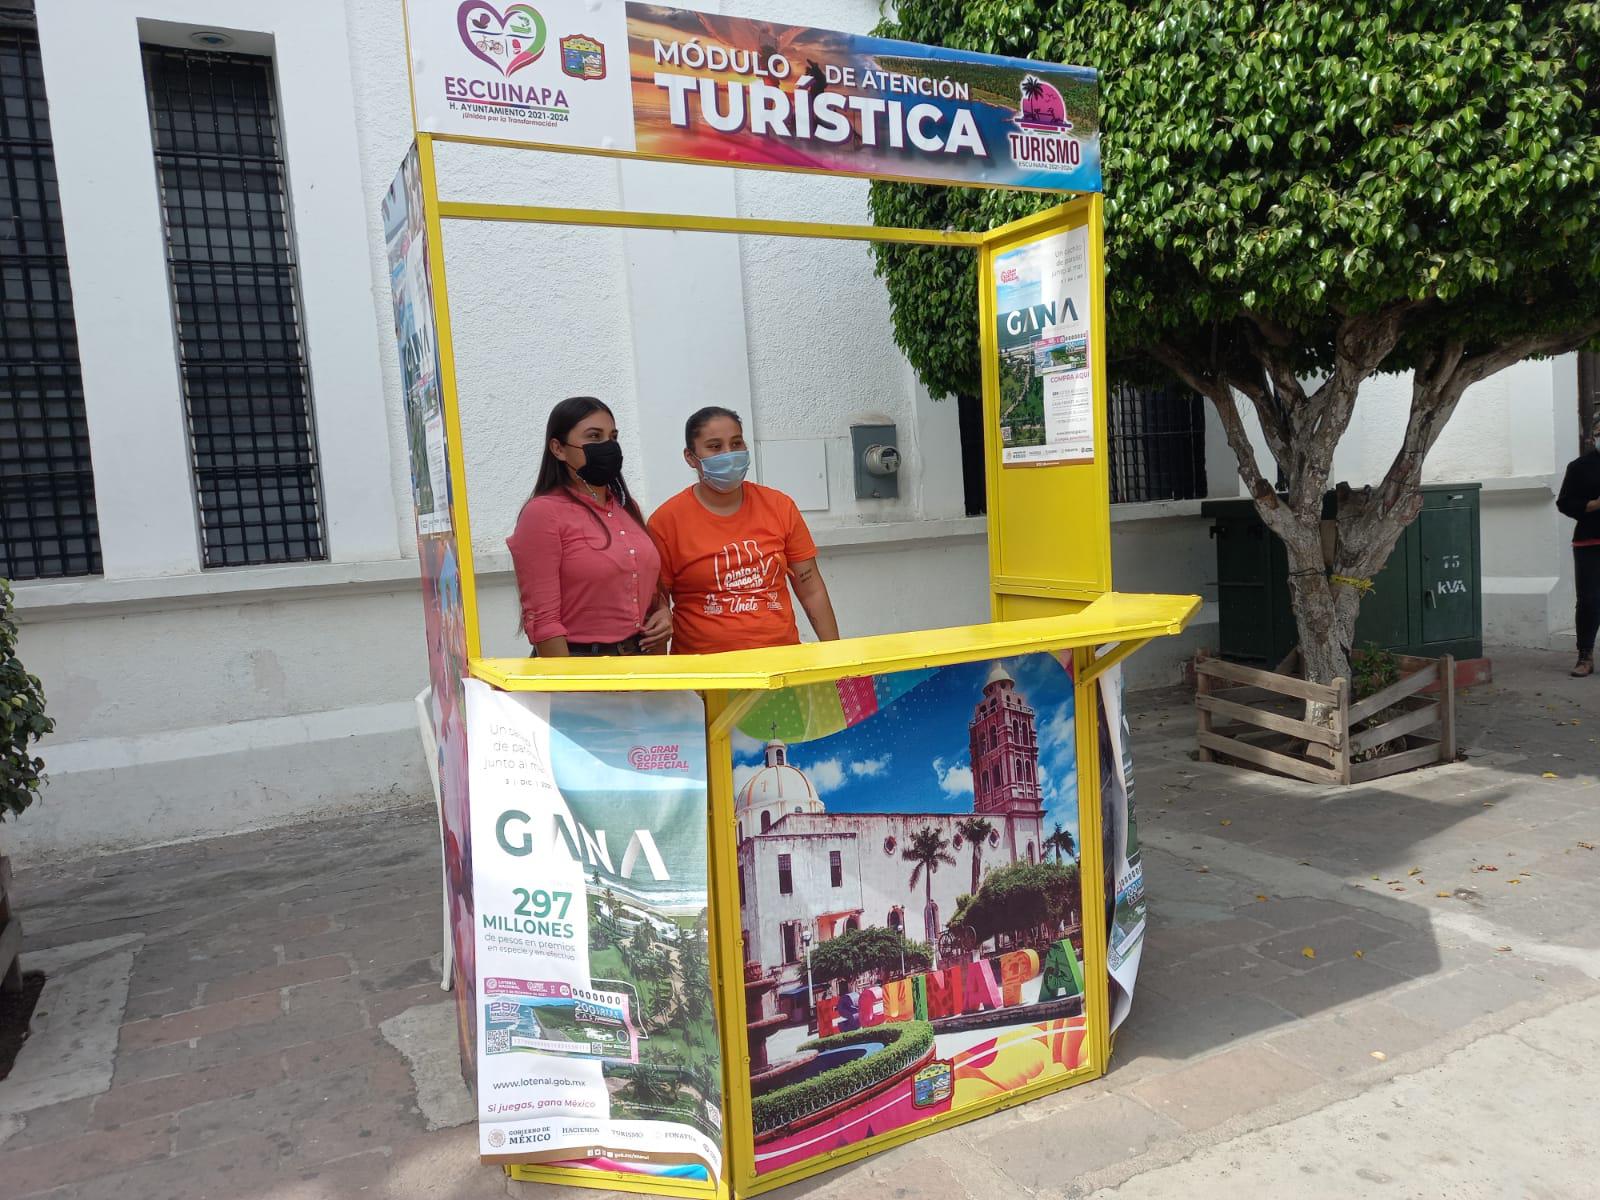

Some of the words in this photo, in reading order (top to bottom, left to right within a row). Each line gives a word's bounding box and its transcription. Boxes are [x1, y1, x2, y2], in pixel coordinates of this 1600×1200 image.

[653, 37, 790, 78] MÓDULO
[826, 65, 855, 87] DE
[862, 70, 969, 100] ATENCIÓN
[445, 76, 569, 108] ESCUINAPA
[450, 102, 458, 111] H.
[461, 103, 526, 117] AYUNTAMIENTO
[528, 110, 569, 122] 2021-2024
[654, 73, 986, 156] TURÍSTICA
[1009, 135, 1080, 165] TURISMO
[1006, 297, 1079, 335] GANA
[1437, 579, 1466, 594] kVA
[637, 752, 679, 762] SORTEO
[650, 744, 679, 753] GRAN
[636, 760, 689, 770] ESPECIAL
[495, 809, 671, 881] GANA
[512, 887, 573, 920] 297
[482, 914, 575, 939] MILLONES
[484, 932, 496, 942] de
[498, 935, 523, 945] pesos
[525, 939, 536, 947] en
[538, 939, 576, 952] premios
[487, 944, 498, 952] en
[499, 945, 528, 955] especie
[572, 987, 621, 1005] 0000000
[490, 1002, 520, 1012] 297
[493, 1077, 586, 1090] www.lotenal.gob.mx
[487, 1103, 498, 1113] Si
[498, 1100, 535, 1114] juegas,
[537, 1099, 562, 1110] gana
[564, 1097, 596, 1109] México
[508, 1127, 541, 1136] GOBIERNO
[508, 1133, 551, 1145] MÉXICO
